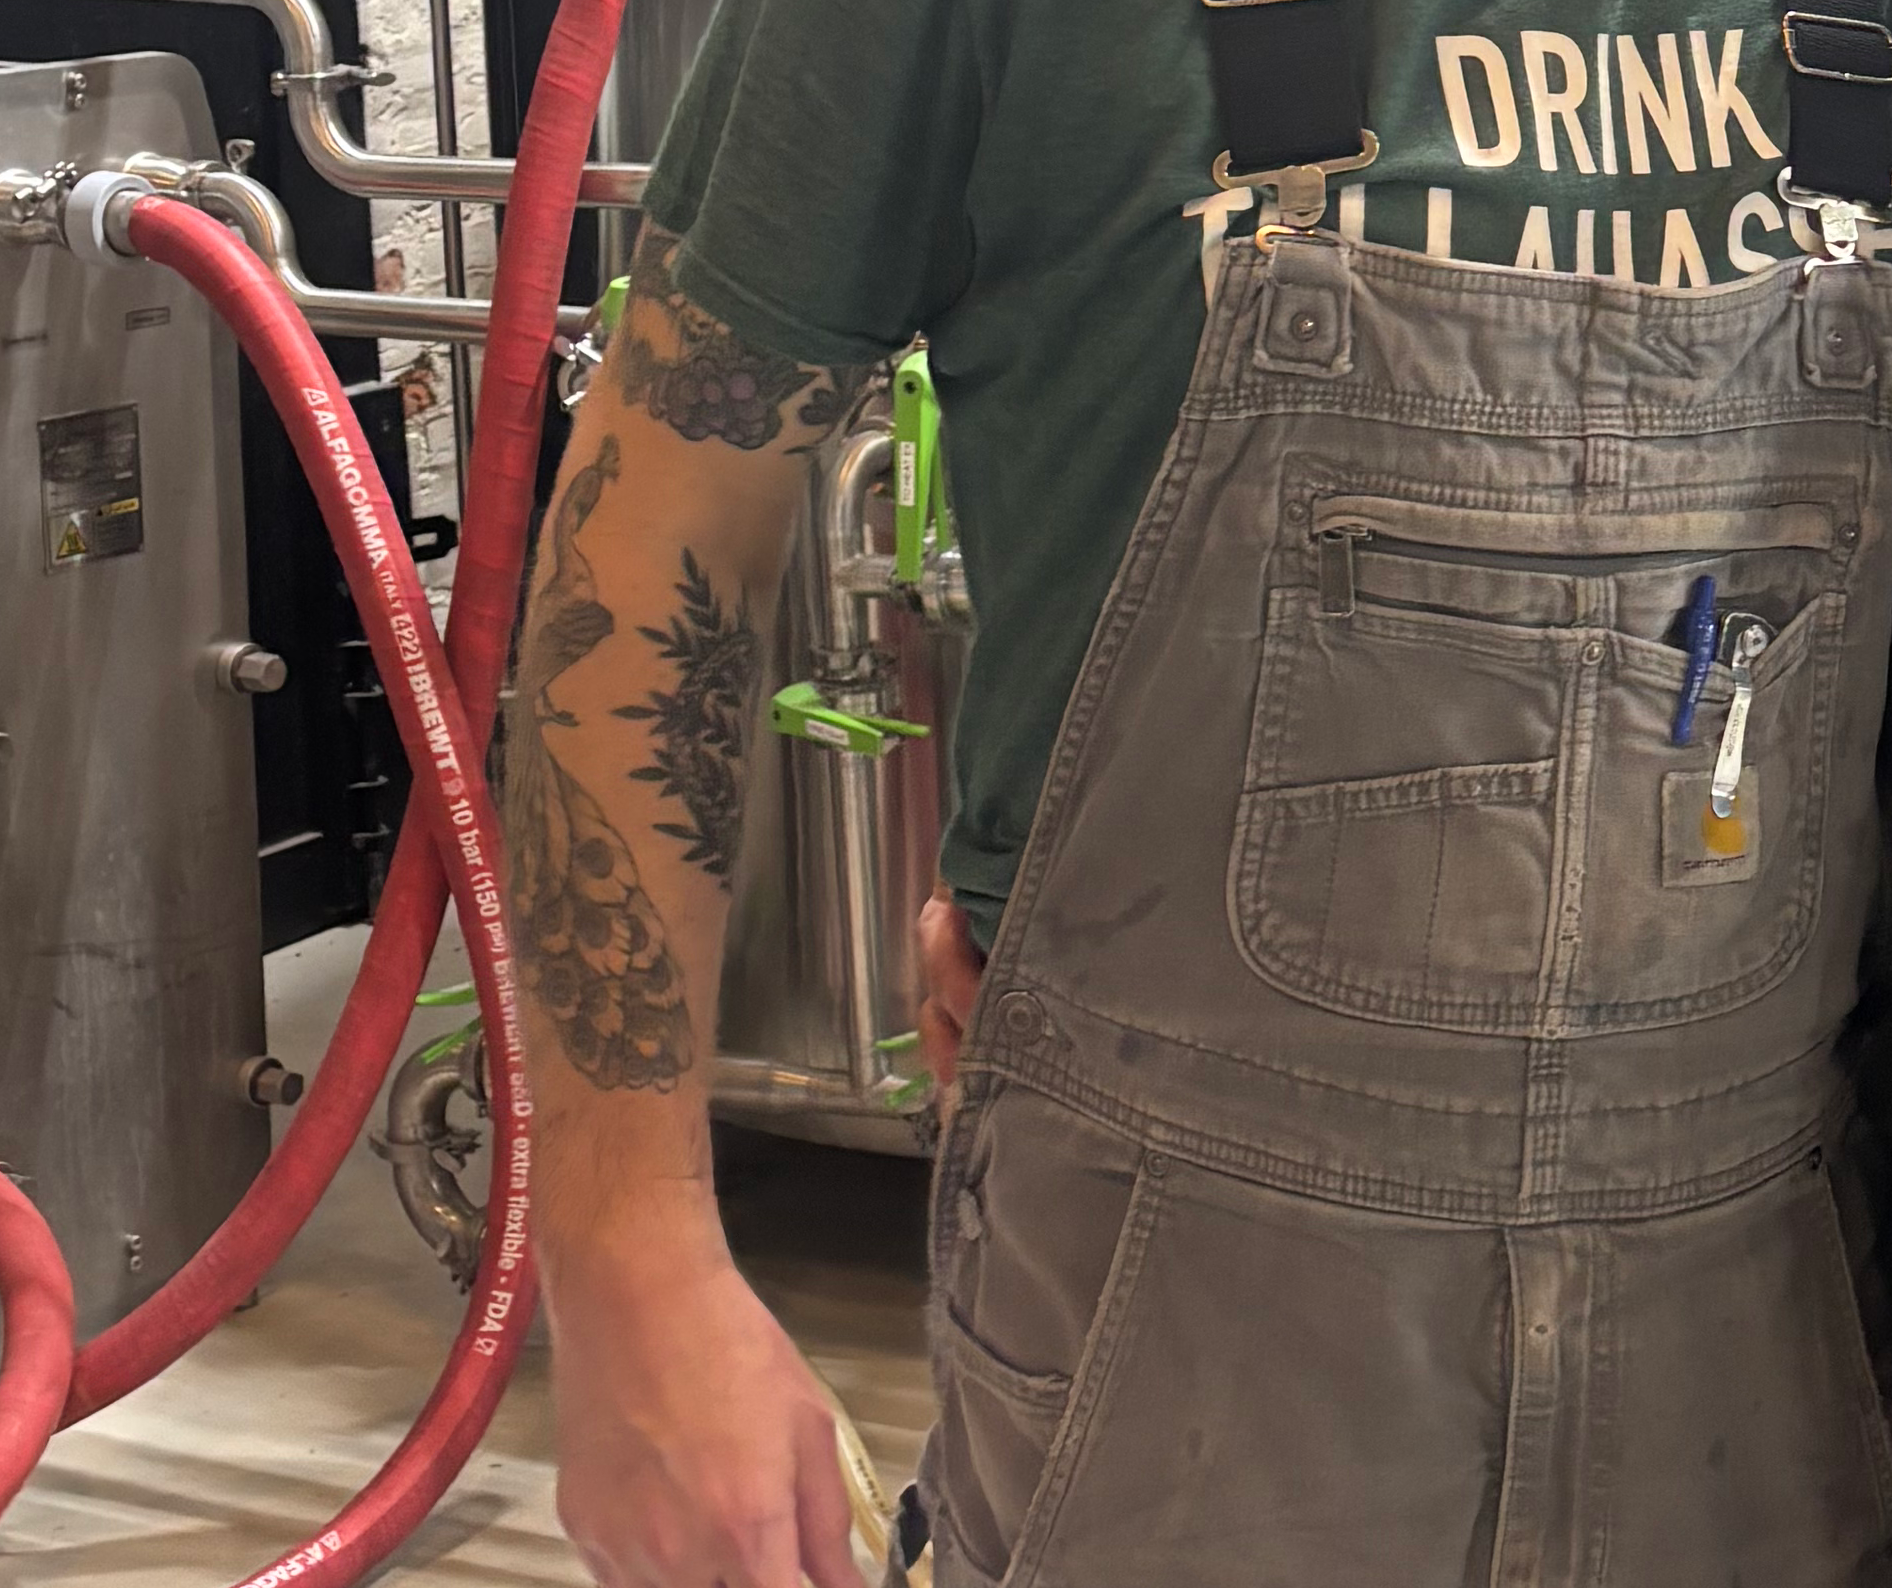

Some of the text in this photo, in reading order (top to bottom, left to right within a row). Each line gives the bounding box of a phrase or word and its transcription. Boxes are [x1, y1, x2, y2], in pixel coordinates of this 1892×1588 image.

[1435, 28, 1785, 175] DRINK
[313, 410, 390, 570] ALFAGOMMA
[379, 570, 403, 610] ITALY
[449, 797, 474, 825] 10
[457, 828, 484, 867] bar
[471, 872, 501, 918] (150
[511, 1137, 531, 1189] extra
[498, 1195, 530, 1270] flexible
[479, 1290, 513, 1332] FDA
